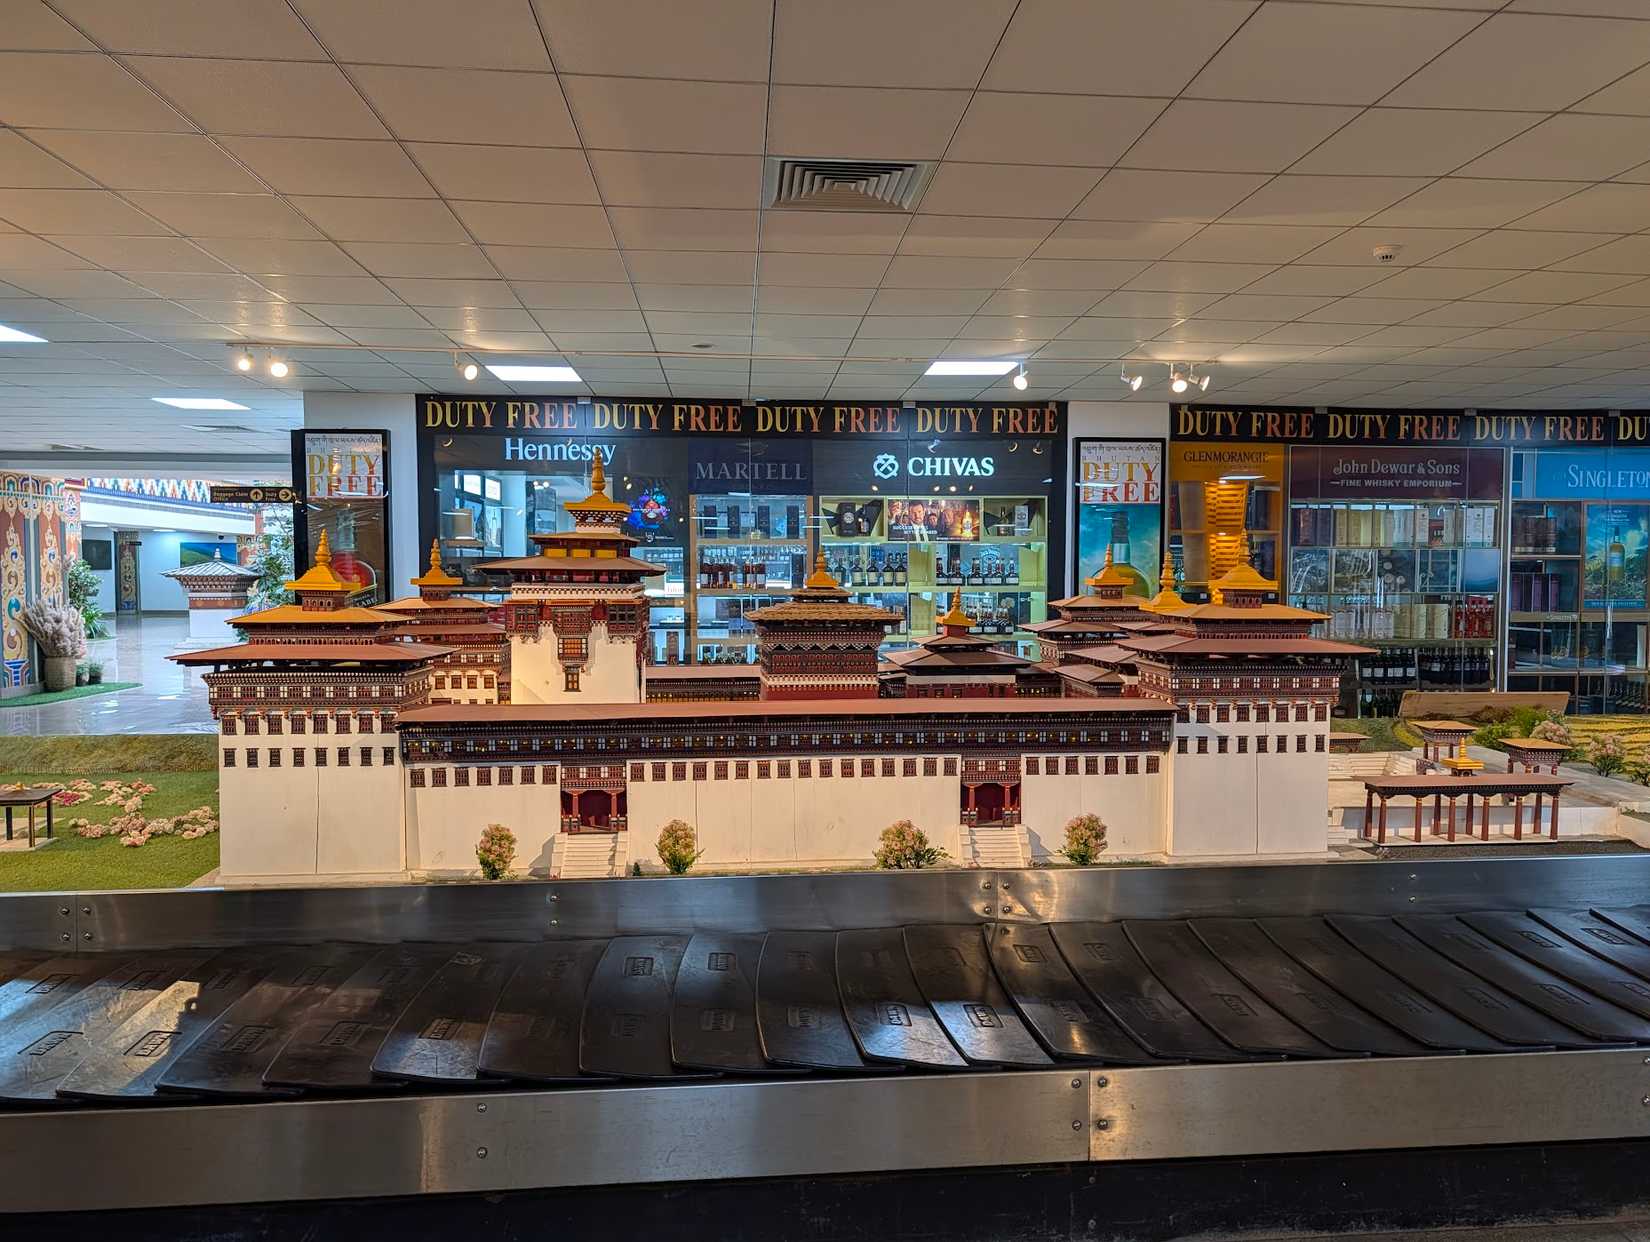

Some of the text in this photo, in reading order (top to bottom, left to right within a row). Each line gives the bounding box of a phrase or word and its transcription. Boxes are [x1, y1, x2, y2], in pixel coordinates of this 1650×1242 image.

[425, 401, 1059, 434] DUTY FREE DUTY FREE DUTY FREE DUTY FREE
[1177, 409, 1242, 436] DUTY
[1250, 411, 1314, 438] FREE
[1327, 414, 1390, 439] DUTY
[1398, 415, 1461, 441] FREE
[1473, 415, 1536, 441] DUTY
[1543, 416, 1605, 441] FREE
[1183, 450, 1269, 463] GLENMORANGIE
[695, 462, 808, 480] MARTELL
[908, 457, 994, 476] CHIVAS
[1083, 462, 1160, 481] DUTY
[1333, 459, 1460, 475] John Dewar & Sons
[308, 475, 381, 497] FREE
[1083, 481, 1160, 502] FREE
[1340, 479, 1361, 487] FINE
[1403, 480, 1452, 488] EMPORIUM
